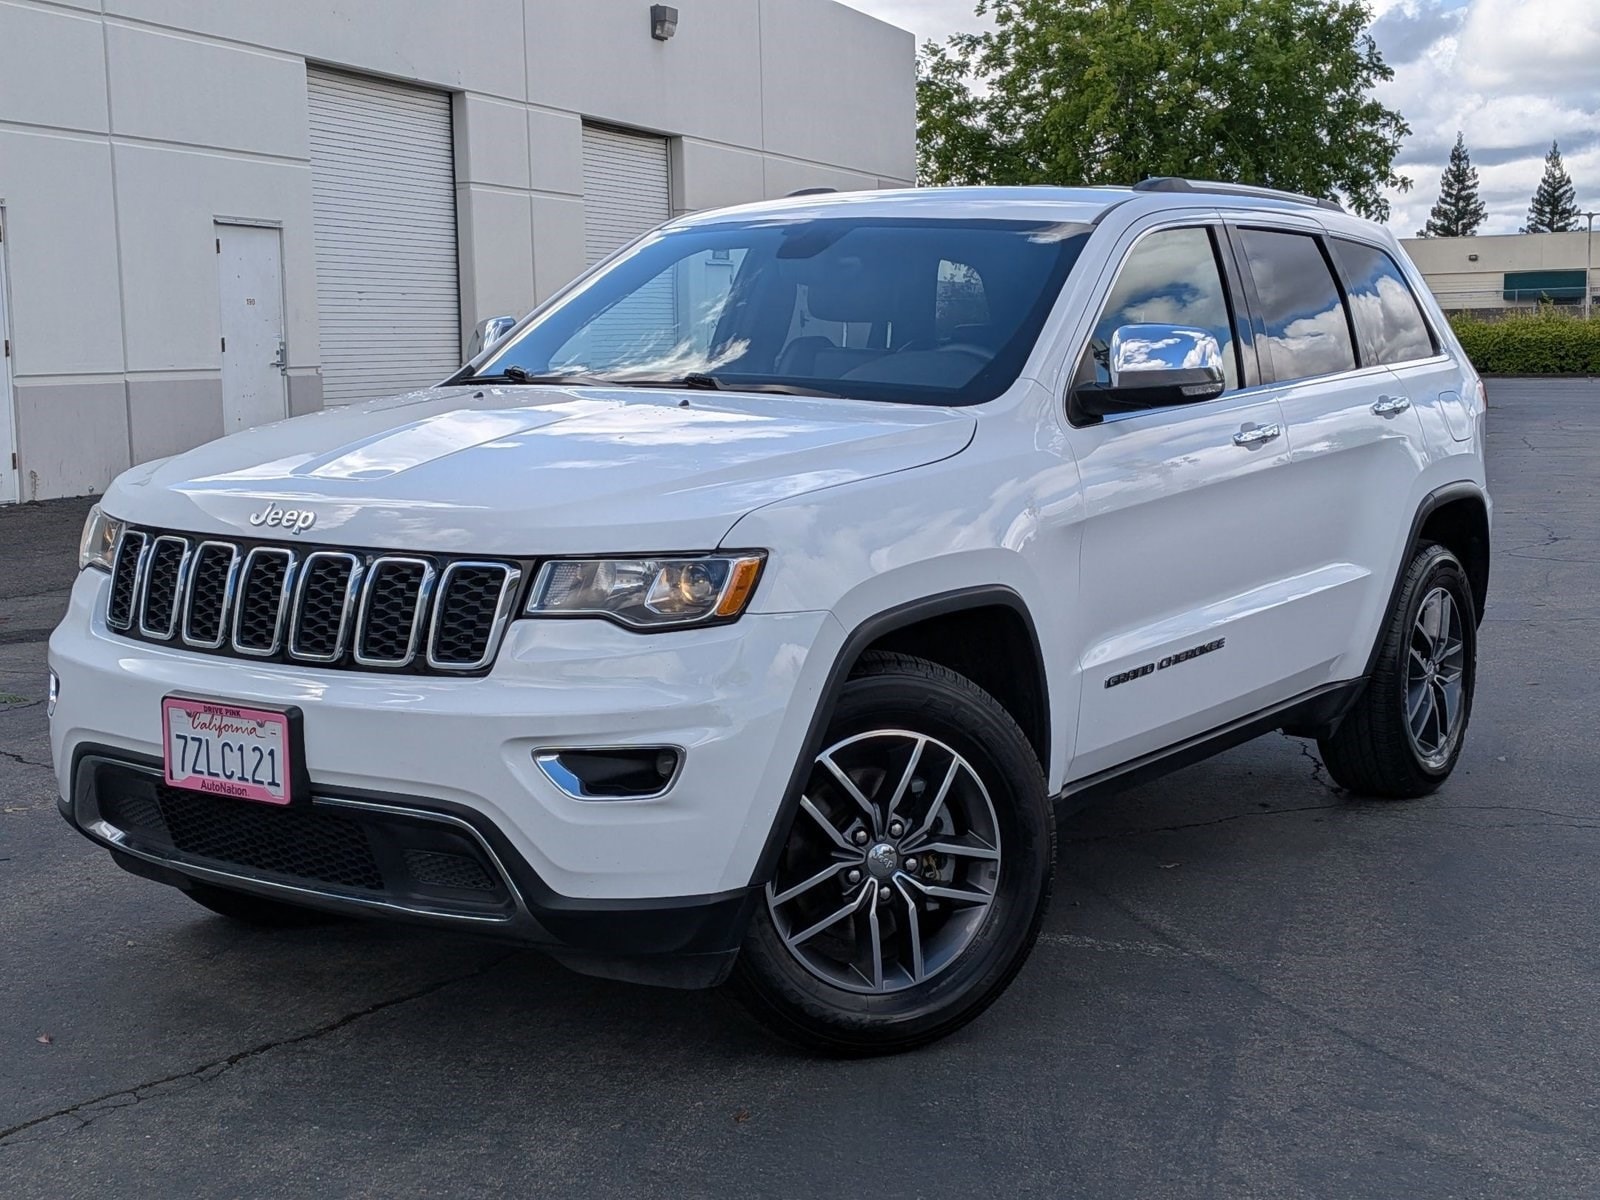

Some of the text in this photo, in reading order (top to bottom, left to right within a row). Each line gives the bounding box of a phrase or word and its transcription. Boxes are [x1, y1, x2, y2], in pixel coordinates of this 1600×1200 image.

[249, 501, 317, 535] Jeep
[1104, 637, 1226, 689] GRAND CHEROKEE
[192, 712, 266, 738] California
[203, 705, 241, 717] DRIVE PINK
[175, 734, 281, 787] 7ZLC121
[200, 780, 248, 796] AutoNation
